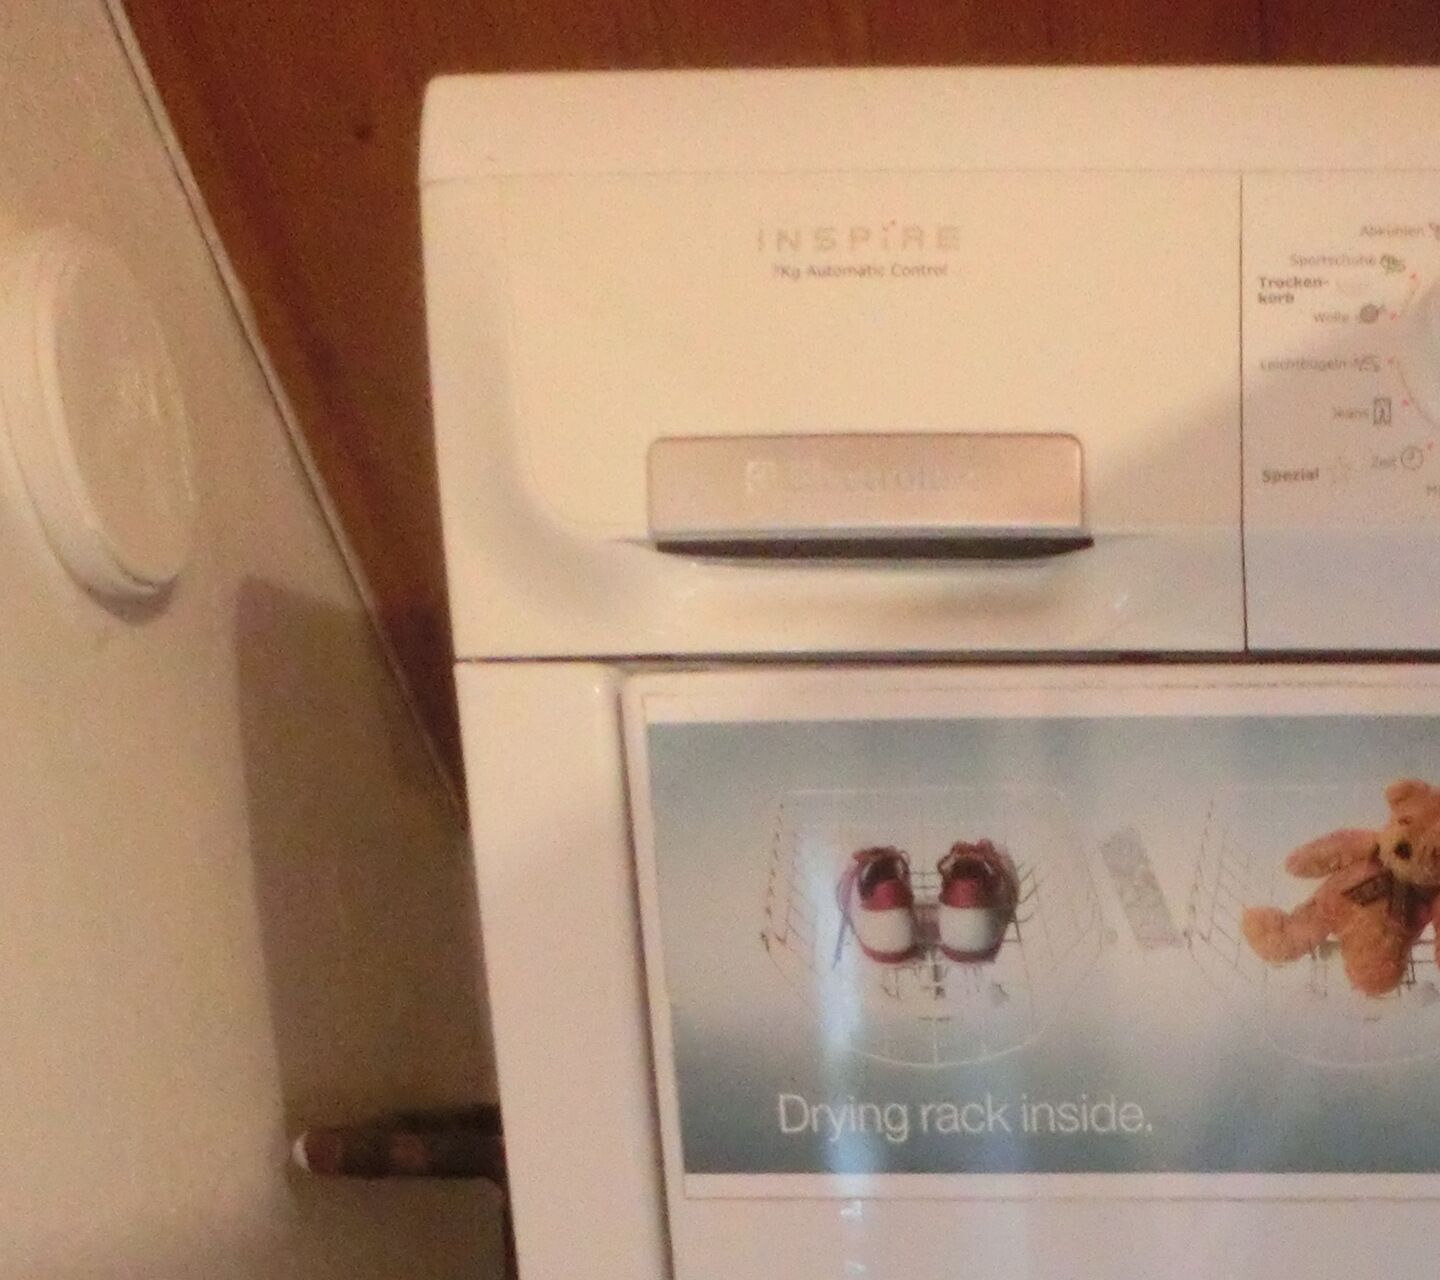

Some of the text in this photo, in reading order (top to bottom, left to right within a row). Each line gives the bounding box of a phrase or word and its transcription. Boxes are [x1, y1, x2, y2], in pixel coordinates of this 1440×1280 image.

[756, 220, 960, 253] INSPIRE
[807, 265, 884, 278] Automatic
[891, 263, 948, 278] Control
[1258, 275, 1330, 289] Trocken-
[1258, 292, 1295, 305] korb
[1262, 467, 1320, 484] Spezial
[778, 1093, 1153, 1142] Drying rack inside.
